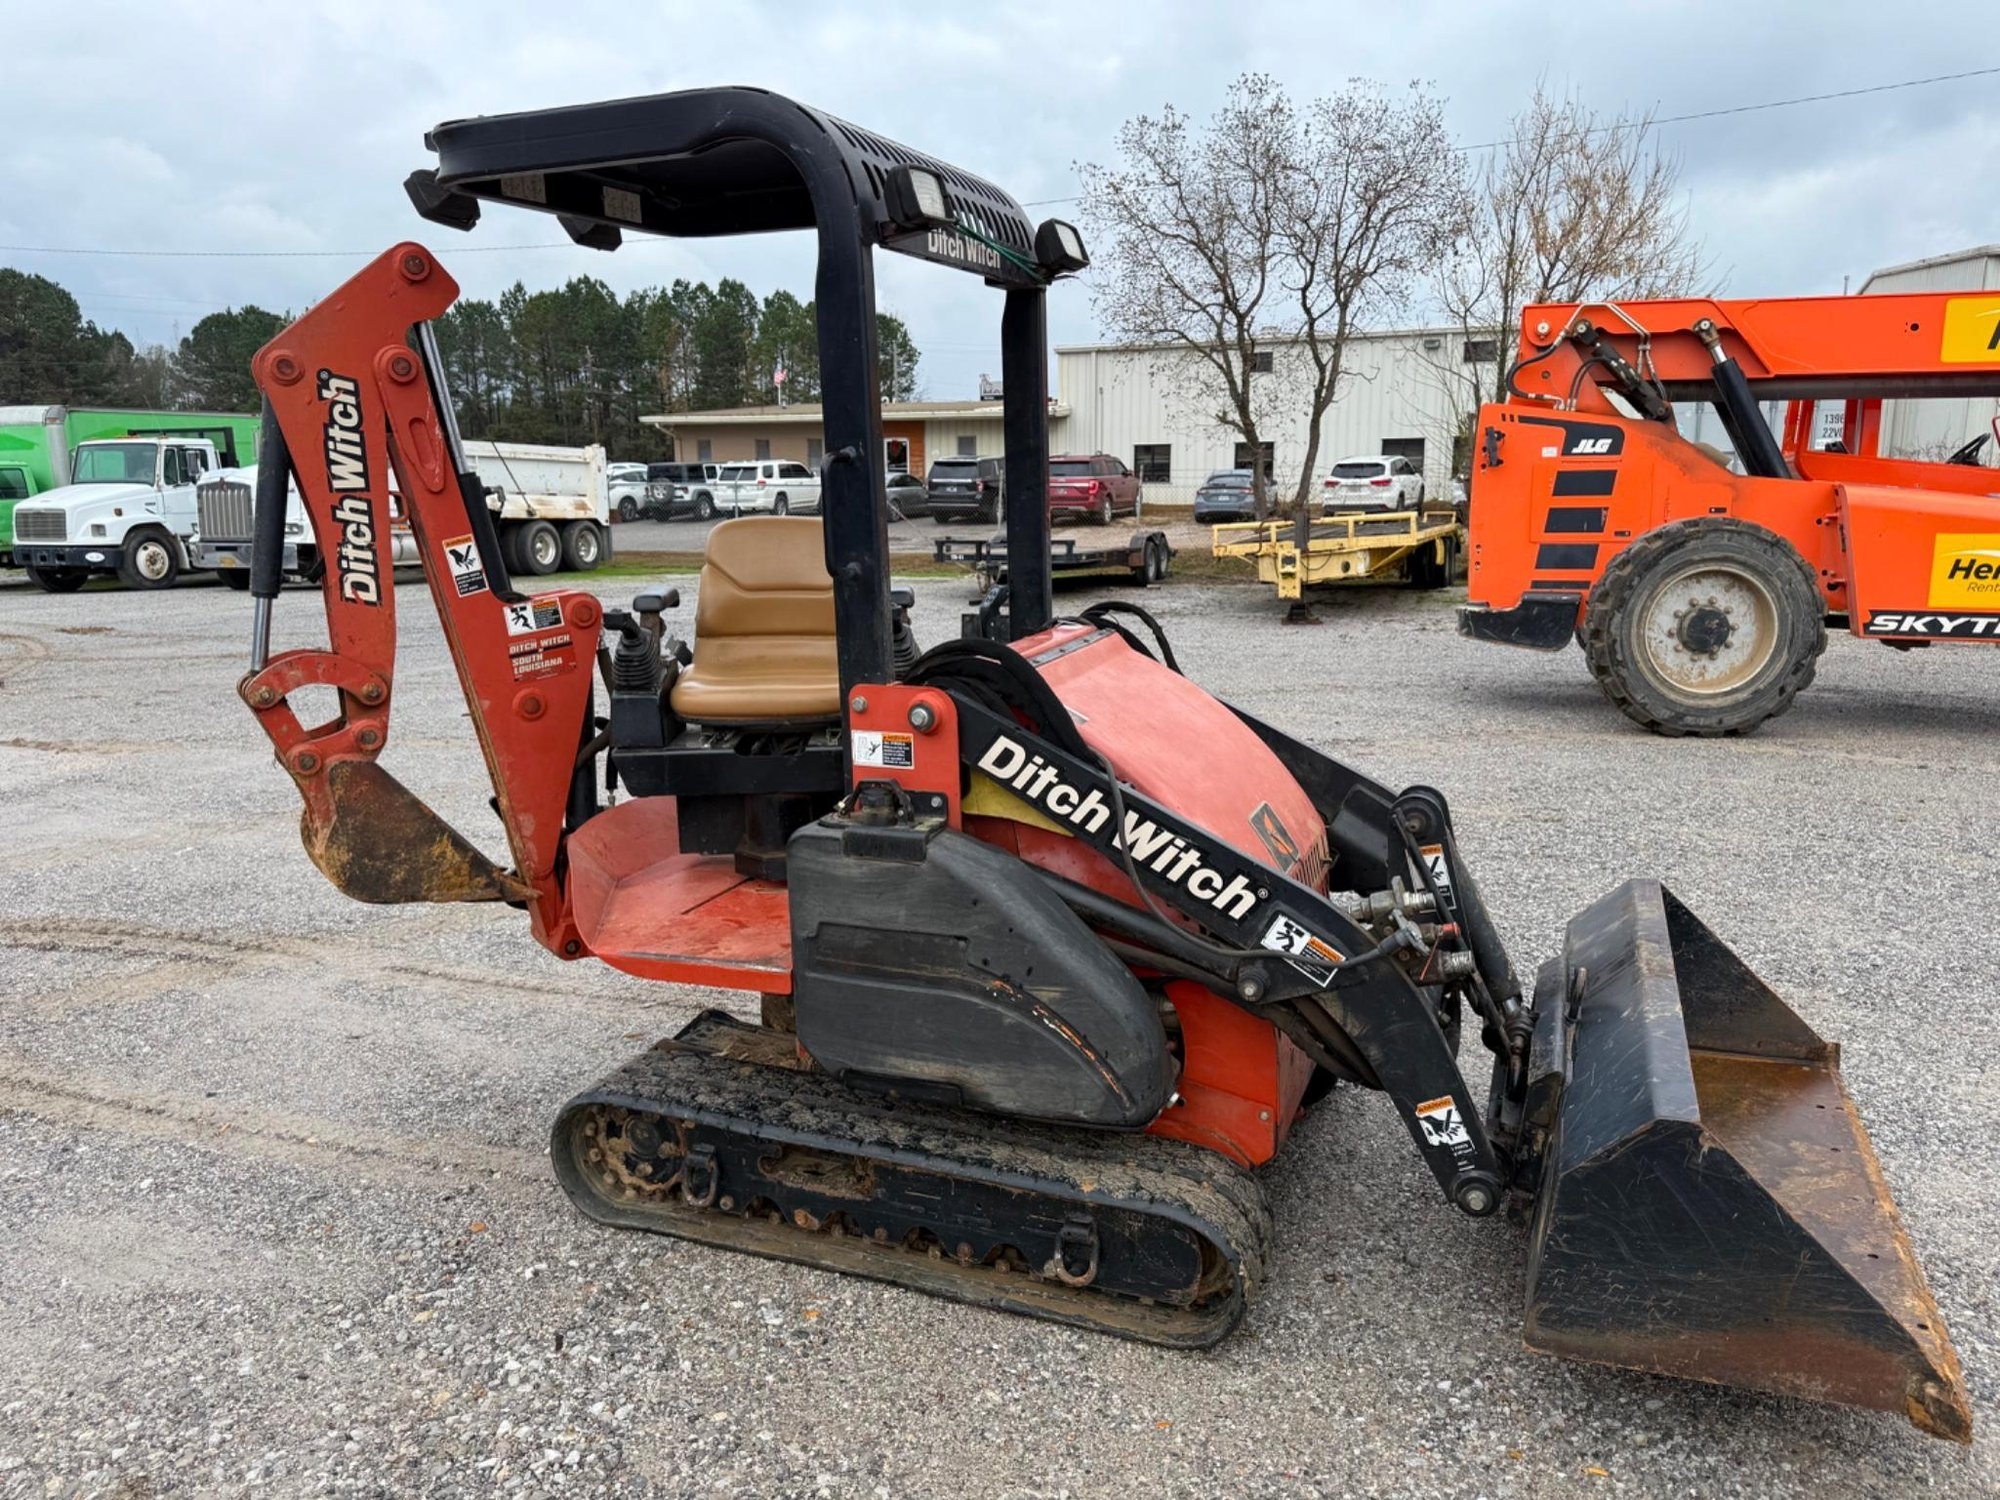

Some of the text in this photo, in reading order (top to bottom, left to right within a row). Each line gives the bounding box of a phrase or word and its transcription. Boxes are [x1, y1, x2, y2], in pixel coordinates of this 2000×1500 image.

[1571, 438, 1613, 454] JLG
[336, 497, 379, 604] Ditch
[509, 633, 570, 655] DITCH WITCH
[512, 653, 543, 667] SOUTH
[514, 656, 563, 675] LOUISIANA
[977, 734, 1110, 833] Ditch
